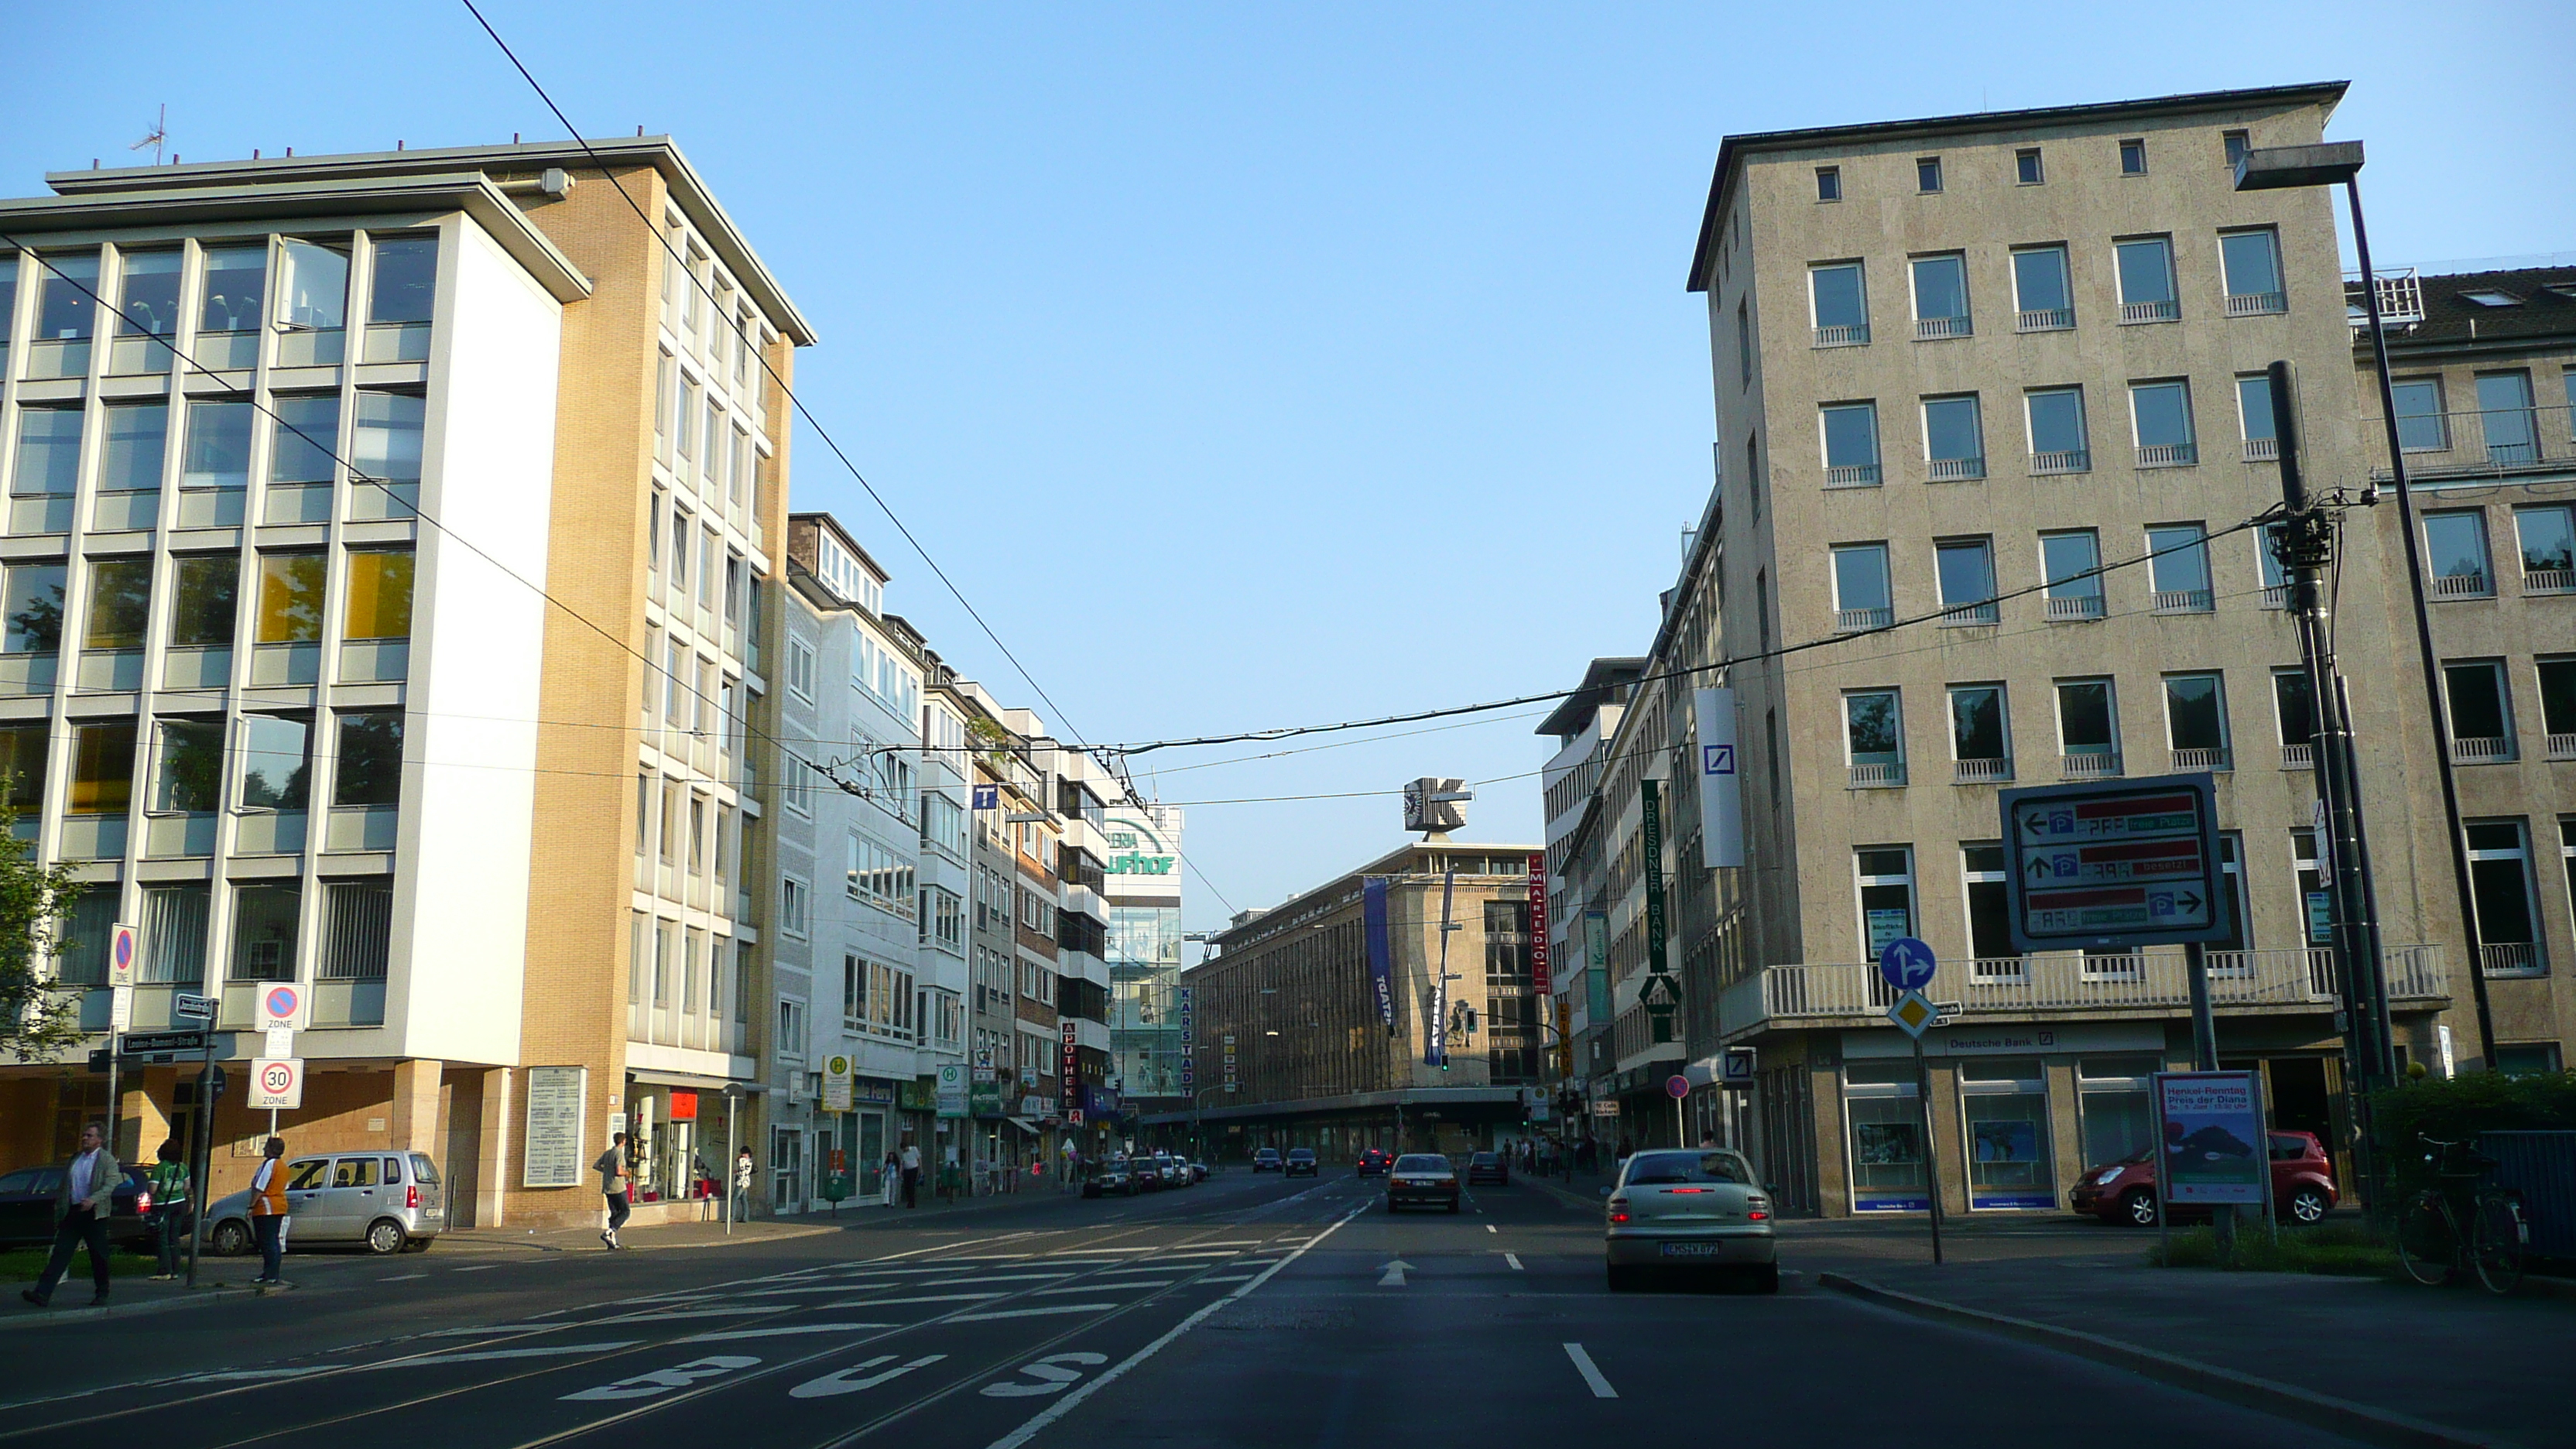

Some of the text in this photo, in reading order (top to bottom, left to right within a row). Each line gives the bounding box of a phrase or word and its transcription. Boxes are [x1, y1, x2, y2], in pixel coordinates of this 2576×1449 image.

[976, 788, 995, 807] T
[1646, 800, 1663, 951] DRESDNER BANK
[1530, 873, 1545, 960] MAREDO
[115, 971, 128, 983] ZONE
[268, 1019, 293, 1029] ZONE
[1181, 989, 1192, 1097] KARSTADT
[1951, 1037, 2033, 1049] Deutsche Bank
[1064, 1023, 1074, 1108] APOTHEKE
[267, 1071, 286, 1086] 30
[2168, 1087, 2247, 1096] Henkel-Renntag
[262, 1095, 288, 1105] ZONE
[2217, 1095, 2247, 1104] Diana
